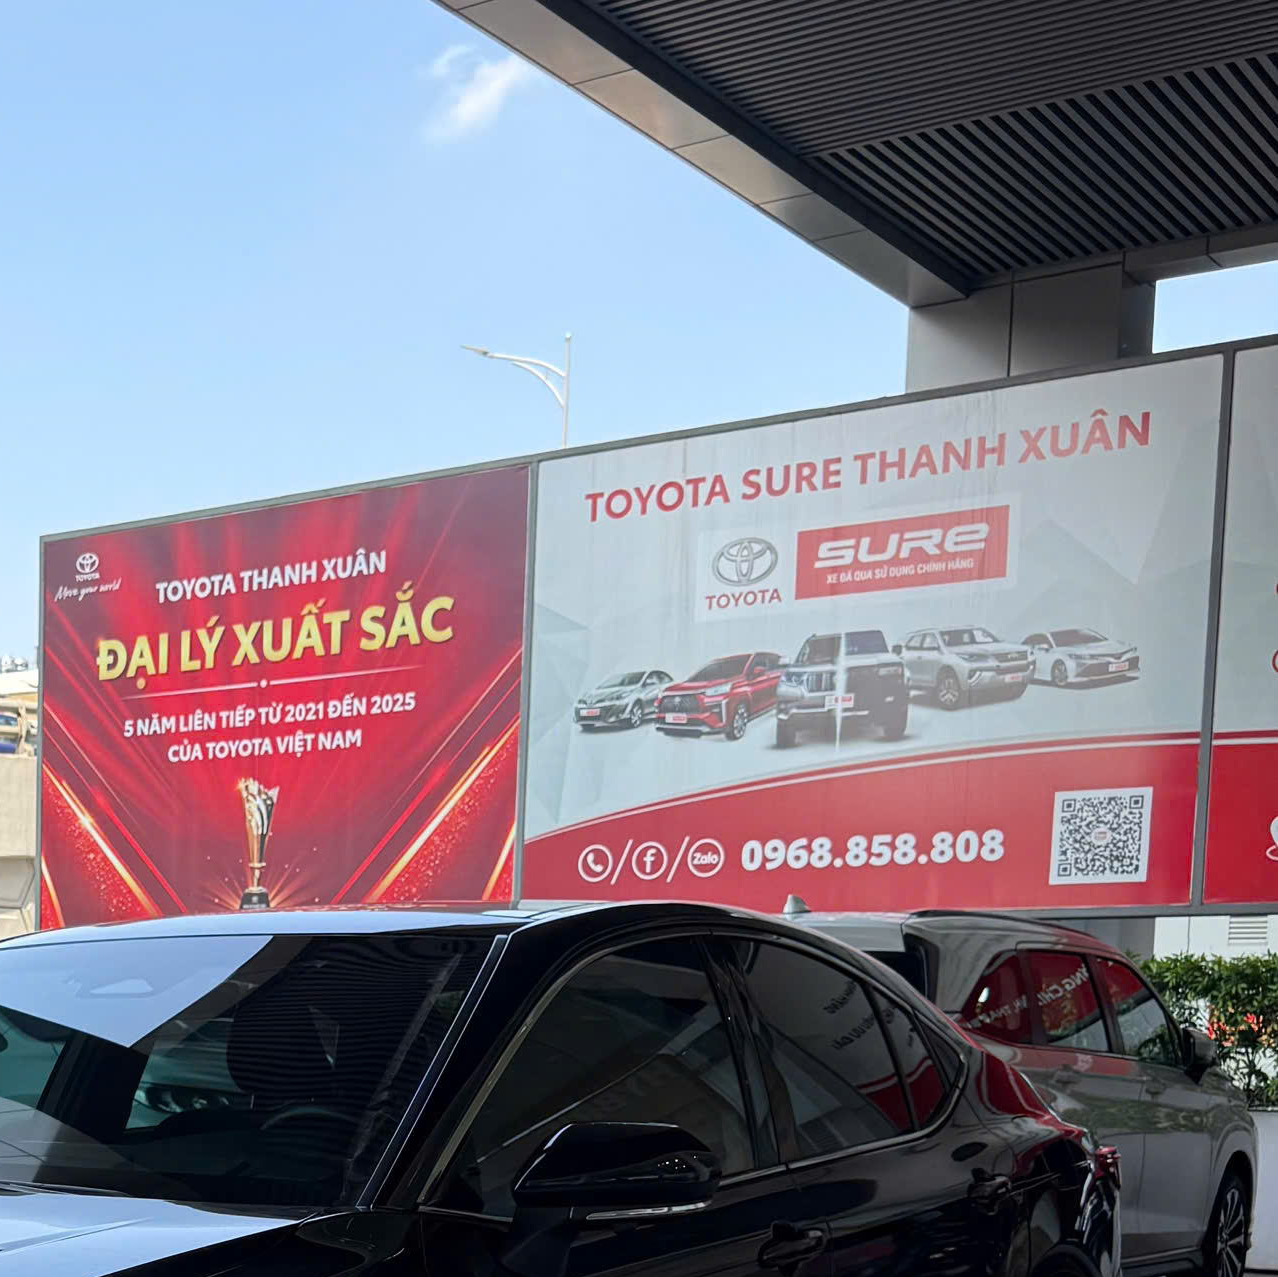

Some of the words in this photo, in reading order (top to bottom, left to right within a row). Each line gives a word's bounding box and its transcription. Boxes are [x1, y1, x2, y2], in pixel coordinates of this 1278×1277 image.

[585, 474, 730, 523] TOYOTA
[741, 457, 842, 500] SURE
[853, 432, 1007, 485] THANH
[1018, 408, 1151, 464] XUÂN
[156, 574, 236, 603] TOYOTA
[239, 561, 317, 593] THANH
[322, 547, 387, 582] XUÂN
[826, 573, 838, 584] XE
[854, 570, 873, 582] QUA
[705, 588, 782, 610] TOYOTA
[96, 632, 169, 690] ĐẠI
[180, 615, 225, 673] LÝ
[232, 598, 351, 667] XUẤT
[360, 580, 455, 652] SẮC
[124, 720, 134, 737] 5
[136, 715, 173, 736] NĂM
[179, 709, 216, 733] LIÊN
[220, 703, 257, 730] TIẾP
[258, 701, 284, 725] TỪ
[285, 701, 324, 723] 2021
[327, 693, 366, 719] ĐẾN
[370, 692, 416, 715] 2025
[168, 739, 203, 763] CỦA
[205, 737, 273, 760] TOYOTA
[277, 730, 314, 757] VIỆT
[318, 729, 362, 751] NAM
[692, 850, 719, 866] Zalo
[741, 829, 1005, 872] 0968.858.808
